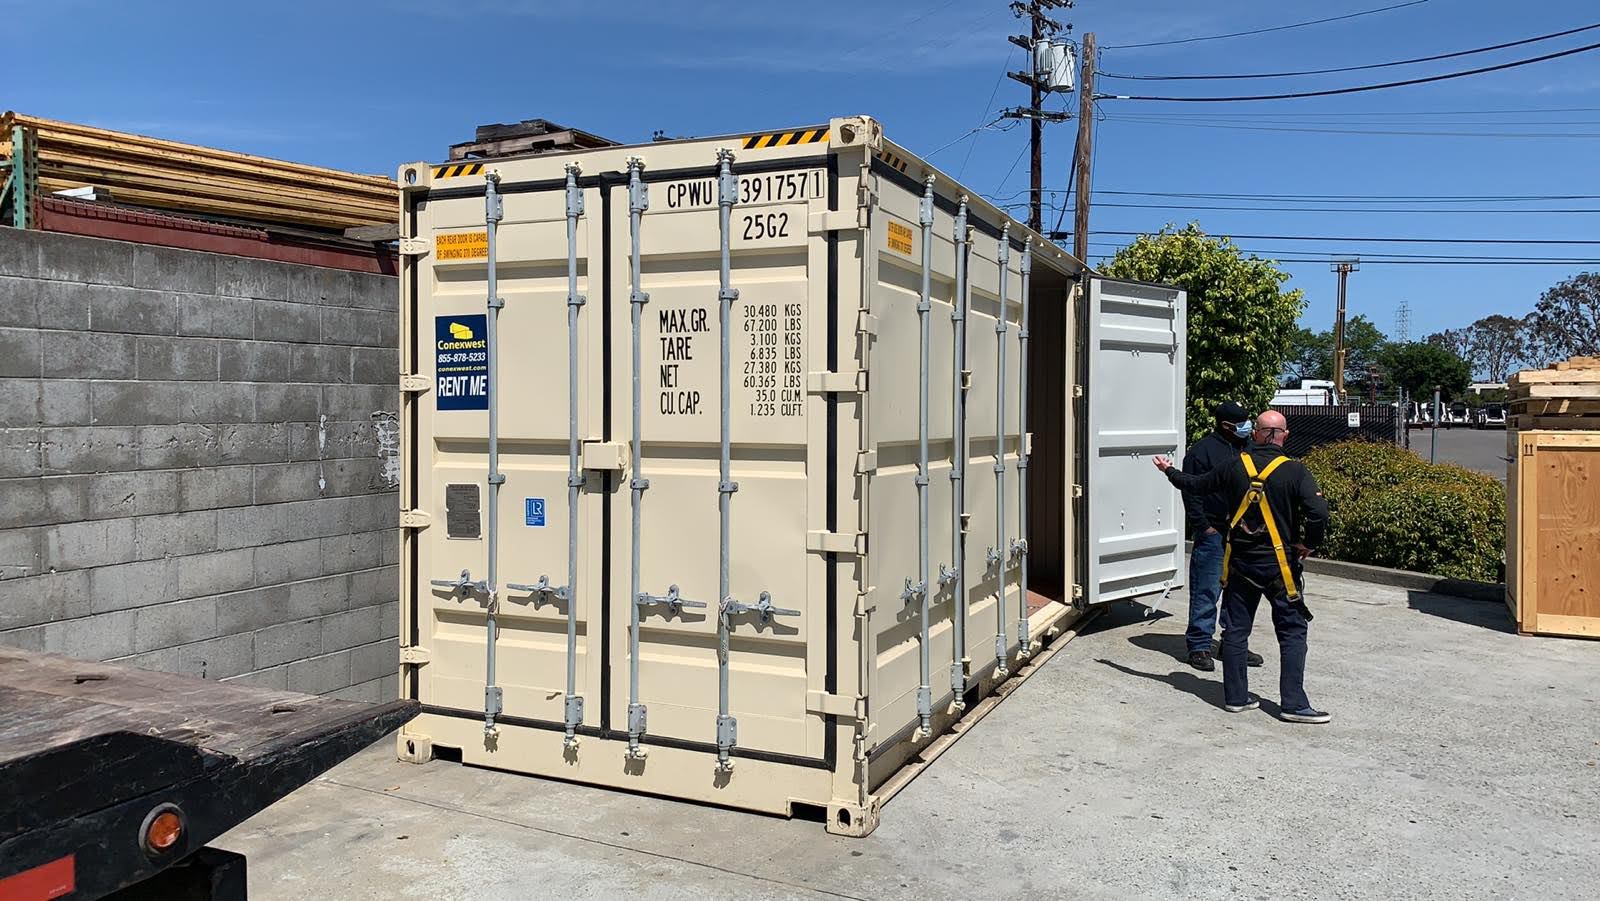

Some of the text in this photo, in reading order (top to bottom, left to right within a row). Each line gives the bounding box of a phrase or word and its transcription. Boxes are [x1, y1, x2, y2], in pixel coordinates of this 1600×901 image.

[667, 181, 713, 208] CPWU
[742, 212, 789, 241] 25G2
[743, 304, 802, 318] 30.480 KGS
[743, 318, 802, 332] 67.200 LBS
[437, 339, 486, 350] Conexwest
[750, 332, 802, 346] 3.100 KGS
[660, 336, 693, 361] TARE
[750, 346, 802, 360] 6.835 LBS
[437, 352, 486, 363] 855-878-5233
[743, 361, 802, 374] 27.380 KGS
[660, 364, 679, 388] NET
[743, 375, 802, 388] 60.365 LBS
[438, 375, 487, 397] RENT ME
[755, 389, 776, 402] 35.0
[750, 403, 776, 416] 1.235
[532, 501, 543, 525] LR
